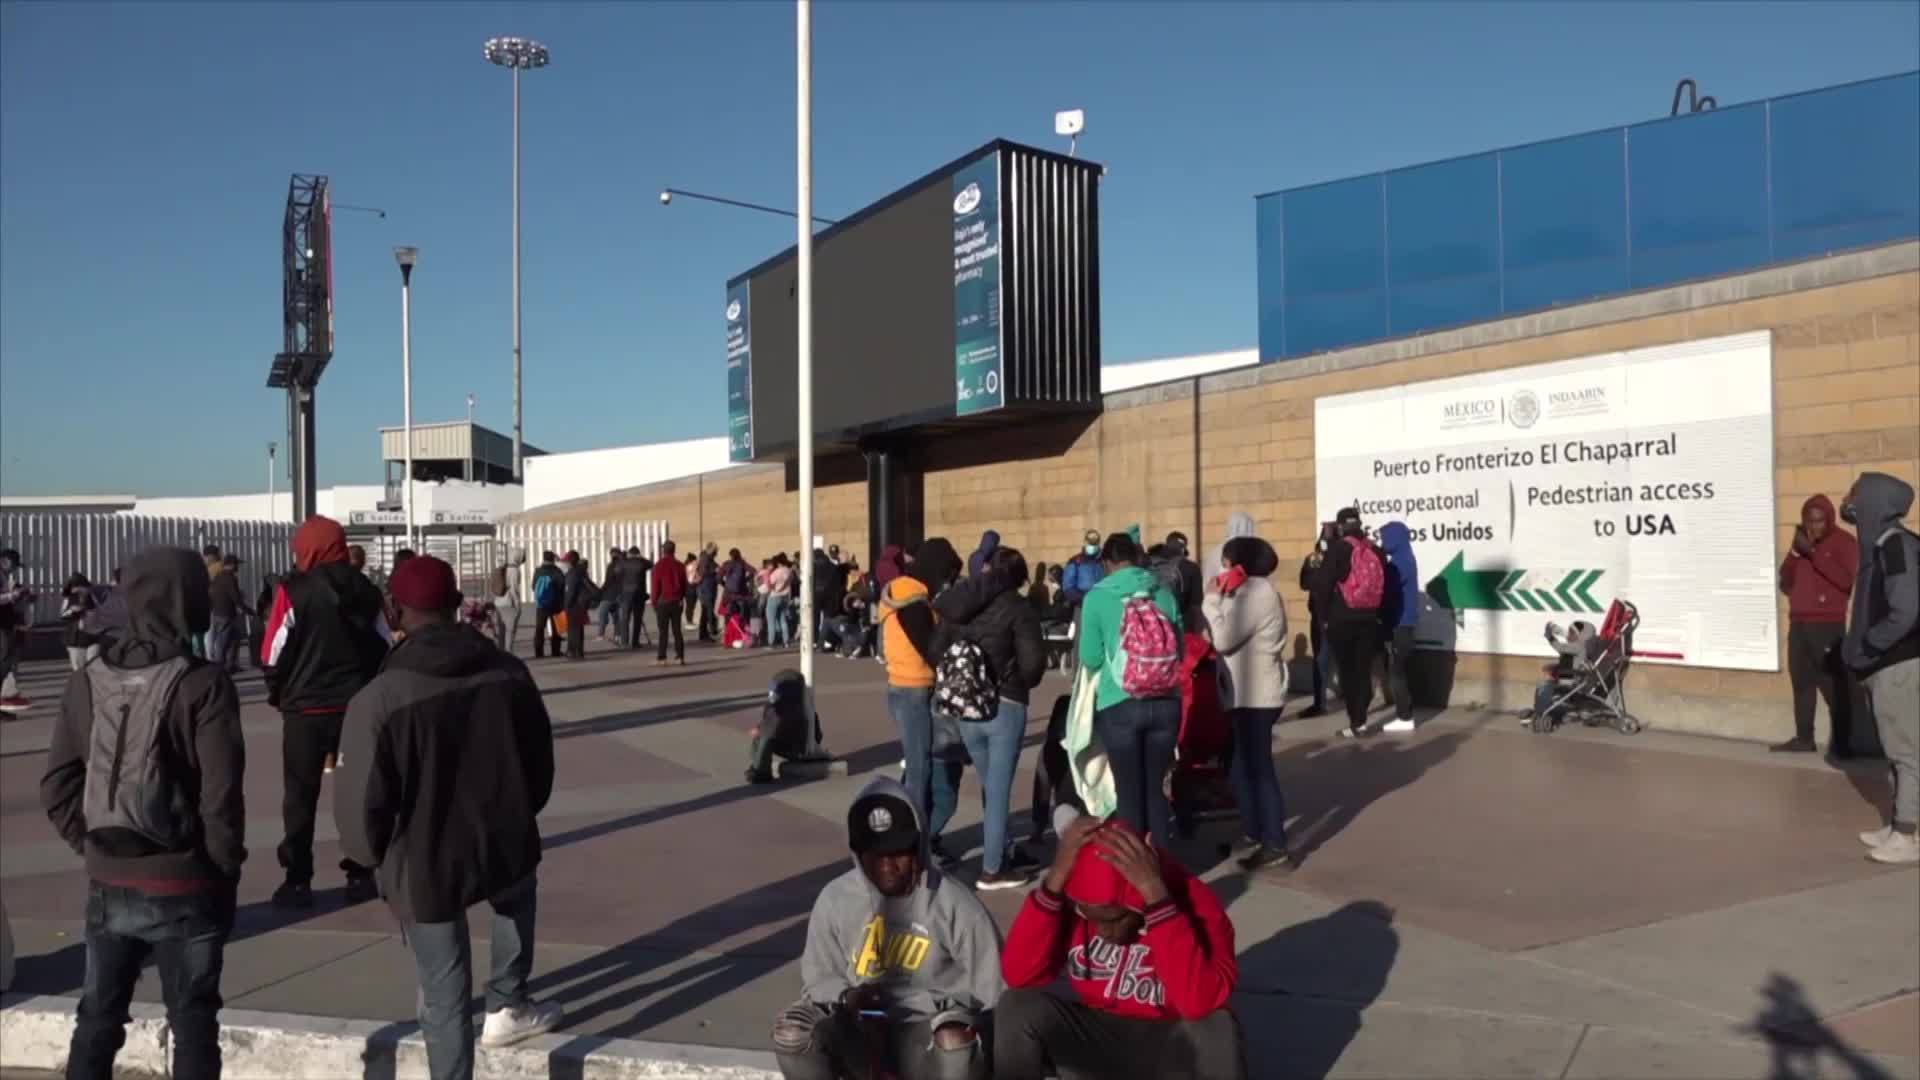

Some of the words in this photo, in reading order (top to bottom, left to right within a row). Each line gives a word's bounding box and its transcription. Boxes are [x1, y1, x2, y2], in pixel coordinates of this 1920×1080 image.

[1374, 459, 1431, 478] Puerto
[1435, 447, 1534, 473] Fronterizo
[1541, 442, 1557, 465] El
[1563, 432, 1676, 465] Chaparral
[1353, 497, 1402, 515] Acceso
[1405, 488, 1479, 515] peatonal
[1528, 481, 1633, 507] Pedestrian
[1640, 482, 1715, 501] access
[1364, 525, 1427, 542] Esos
[1432, 521, 1493, 542] Unidos
[1594, 519, 1615, 537] to
[1625, 513, 1677, 536] USA
